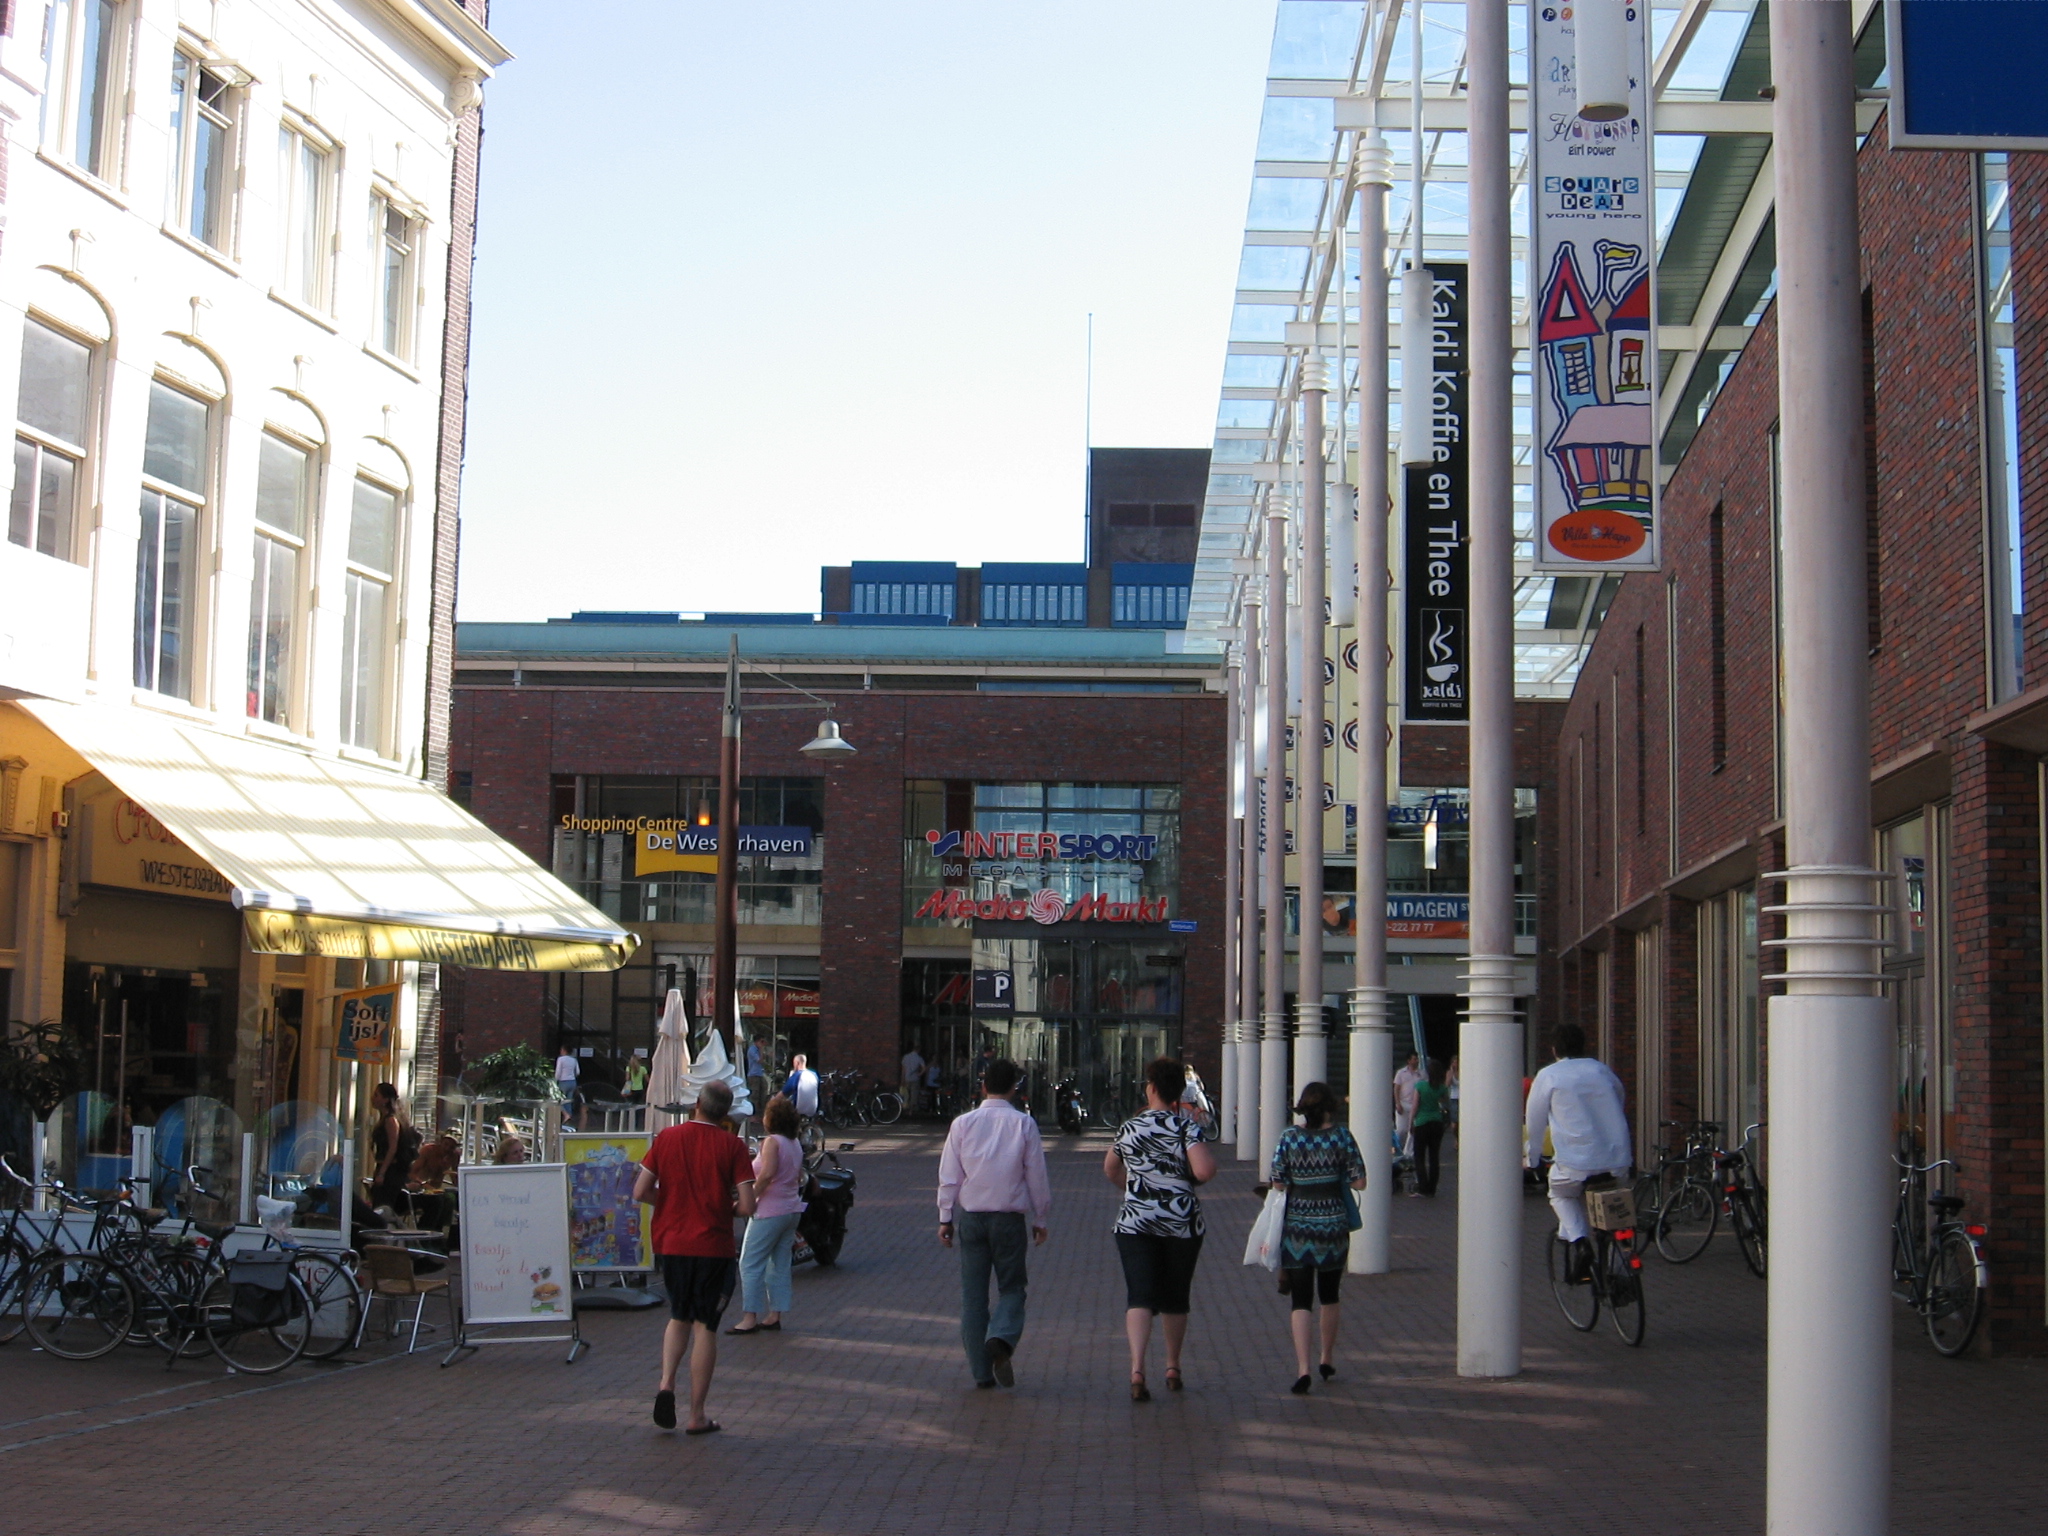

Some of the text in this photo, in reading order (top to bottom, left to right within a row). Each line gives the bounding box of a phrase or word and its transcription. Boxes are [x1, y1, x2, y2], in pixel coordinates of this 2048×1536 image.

[1568, 145, 1616, 156] girl power
[1428, 279, 1460, 597] Kaldi Koffie en Thee
[1423, 683, 1462, 698] kaldi
[647, 833, 805, 852] De Wesrhaven
[963, 830, 1158, 860] INTERSPORT
[141, 859, 233, 894] WESTERHAV
[914, 889, 1168, 922] Media Markt
[1403, 901, 1458, 918] DAGEN
[266, 914, 379, 957] Croissanterie
[1411, 923, 1421, 932] 77
[1423, 923, 1434, 932] 77
[409, 928, 538, 969] WESTERHAVEN
[995, 976, 1010, 998] P
[343, 1002, 389, 1022] Soft
[348, 1020, 380, 1042] ijs!
